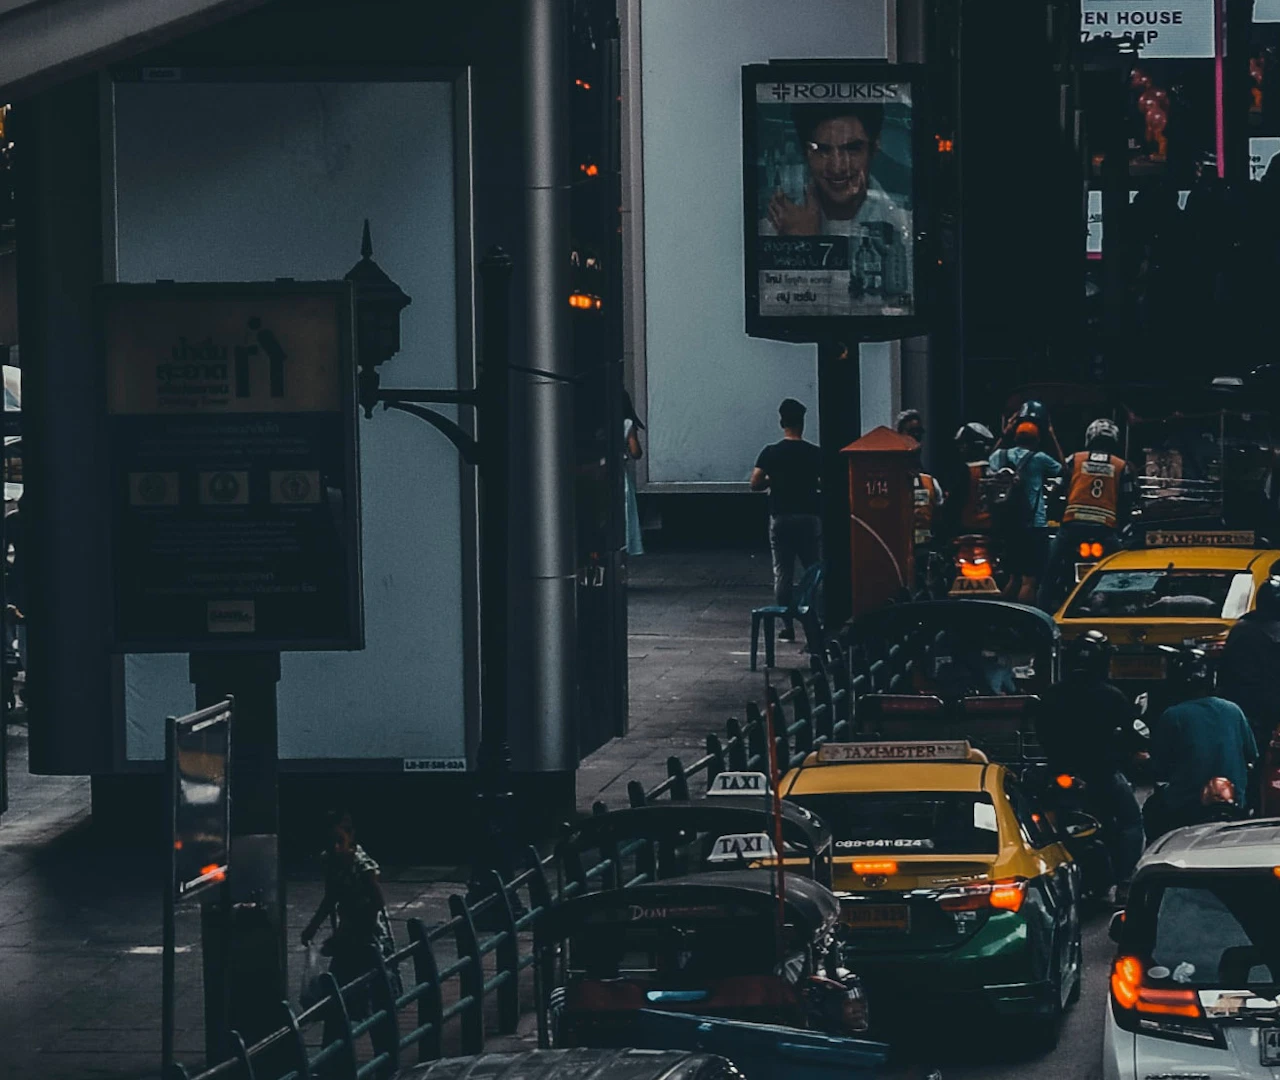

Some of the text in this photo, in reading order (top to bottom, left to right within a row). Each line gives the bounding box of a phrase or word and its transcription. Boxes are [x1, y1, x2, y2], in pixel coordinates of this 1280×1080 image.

[1117, 11, 1182, 25] HOUSE
[794, 83, 898, 99] ROJUKISS
[818, 243, 835, 267] 7
[865, 480, 889, 496] 1/14
[1090, 478, 1104, 498] 8
[844, 745, 936, 759] TAXI-METER
[720, 775, 760, 791] TAXI
[720, 834, 762, 855] TAXI
